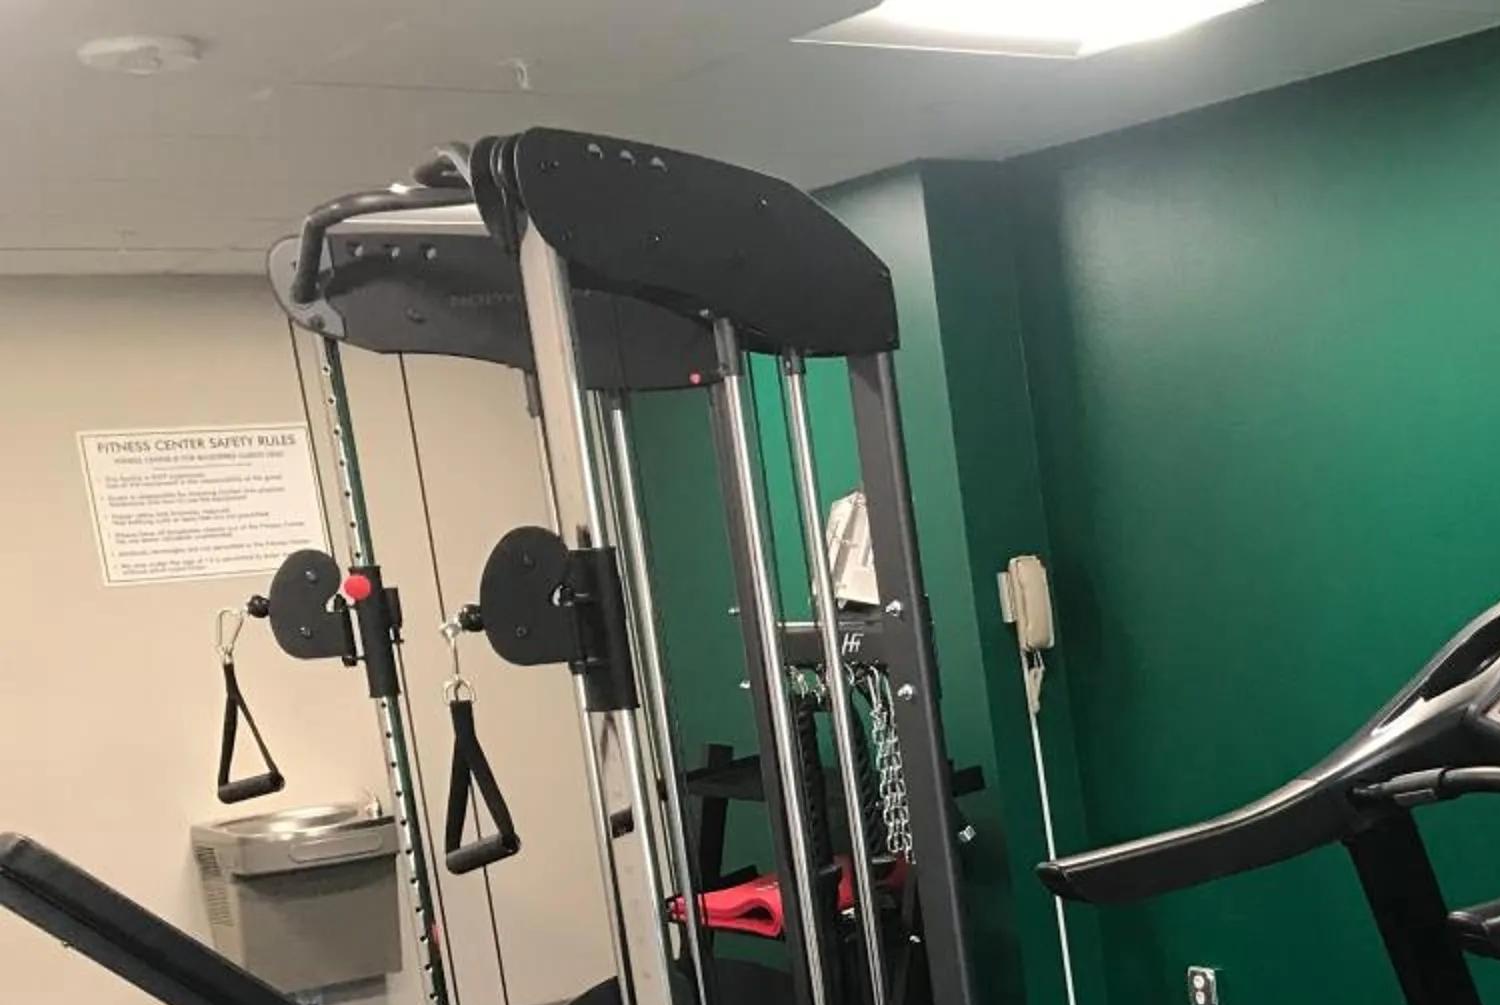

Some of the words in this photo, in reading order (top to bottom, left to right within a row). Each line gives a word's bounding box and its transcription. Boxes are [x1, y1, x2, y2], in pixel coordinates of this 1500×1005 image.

[97, 440, 151, 454] FITNESS
[154, 438, 205, 451] CENTER
[209, 435, 253, 448] SAFETY
[257, 433, 296, 446] RULES
